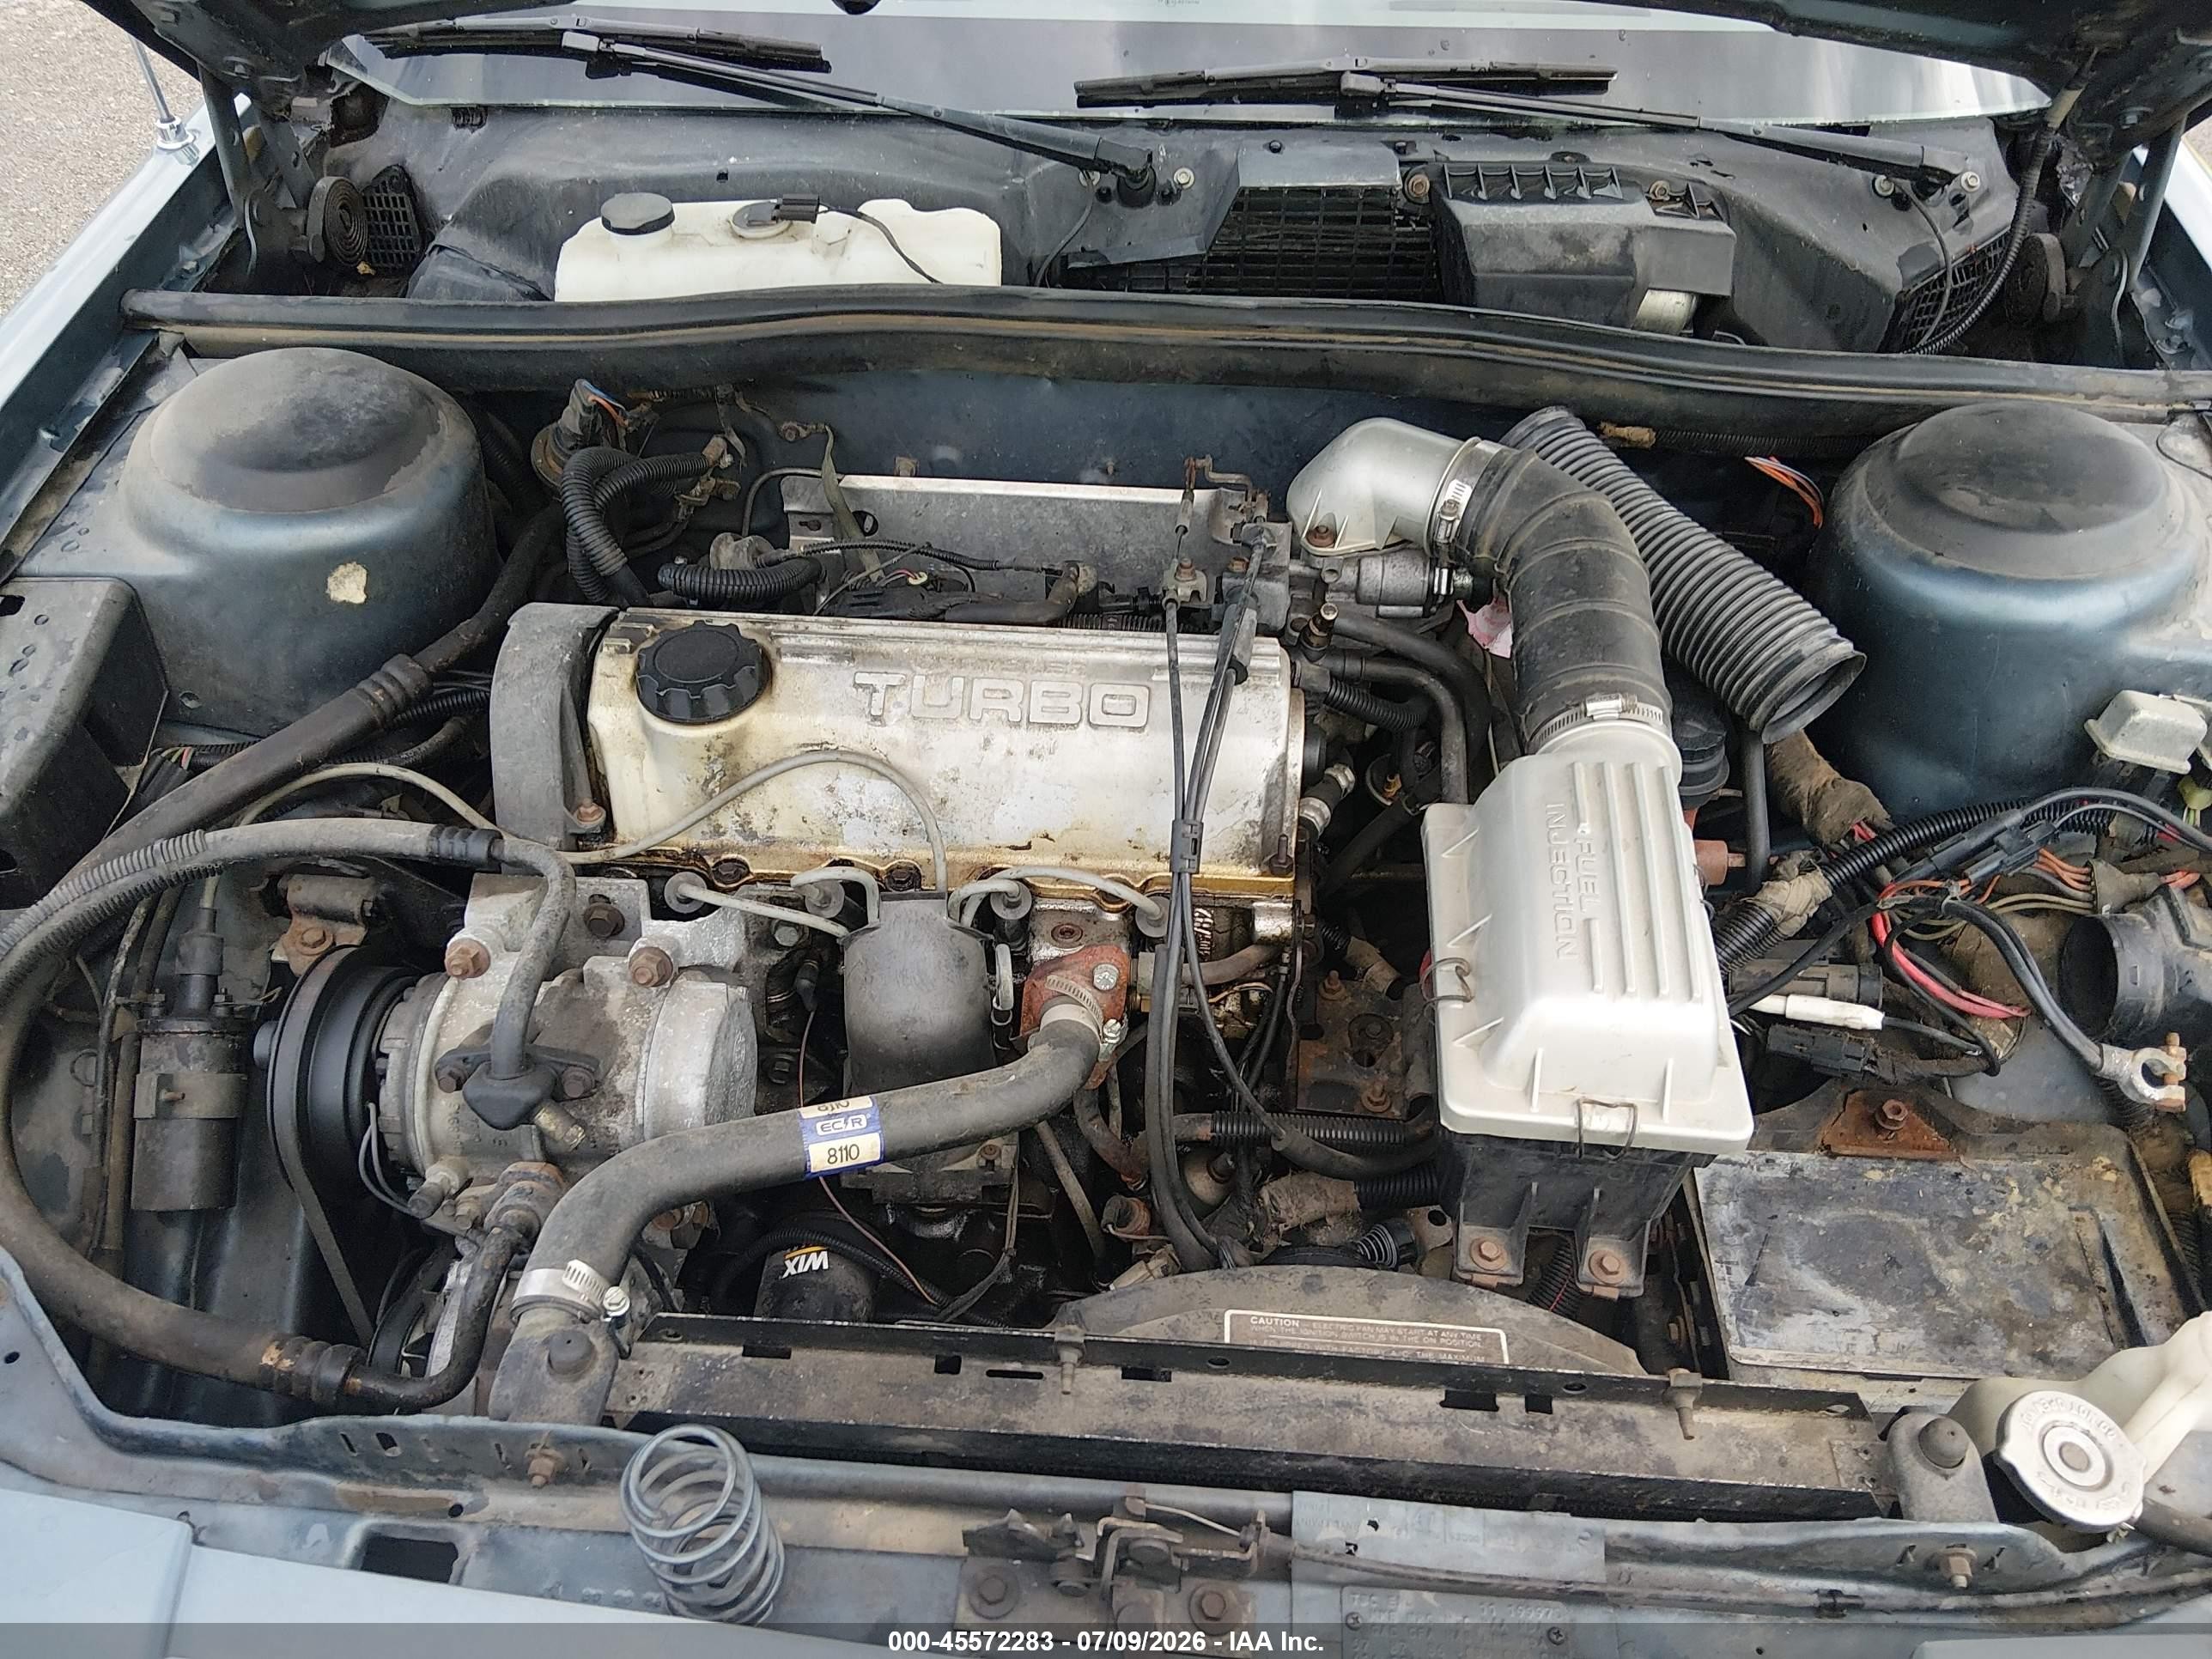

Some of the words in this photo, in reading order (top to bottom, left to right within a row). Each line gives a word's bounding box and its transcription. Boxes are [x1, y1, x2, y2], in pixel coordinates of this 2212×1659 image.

[853, 671, 1151, 727] TURBO
[1547, 803, 1578, 960] INJECTION
[1574, 838, 1601, 913] FUEL
[827, 1144, 860, 1164] 8110
[782, 1251, 829, 1279] WIX
[1250, 1316, 1299, 1328] CAUTION
[1312, 1322, 1354, 1333] ELECTRIC
[1461, 1332, 1482, 1340] TIME
